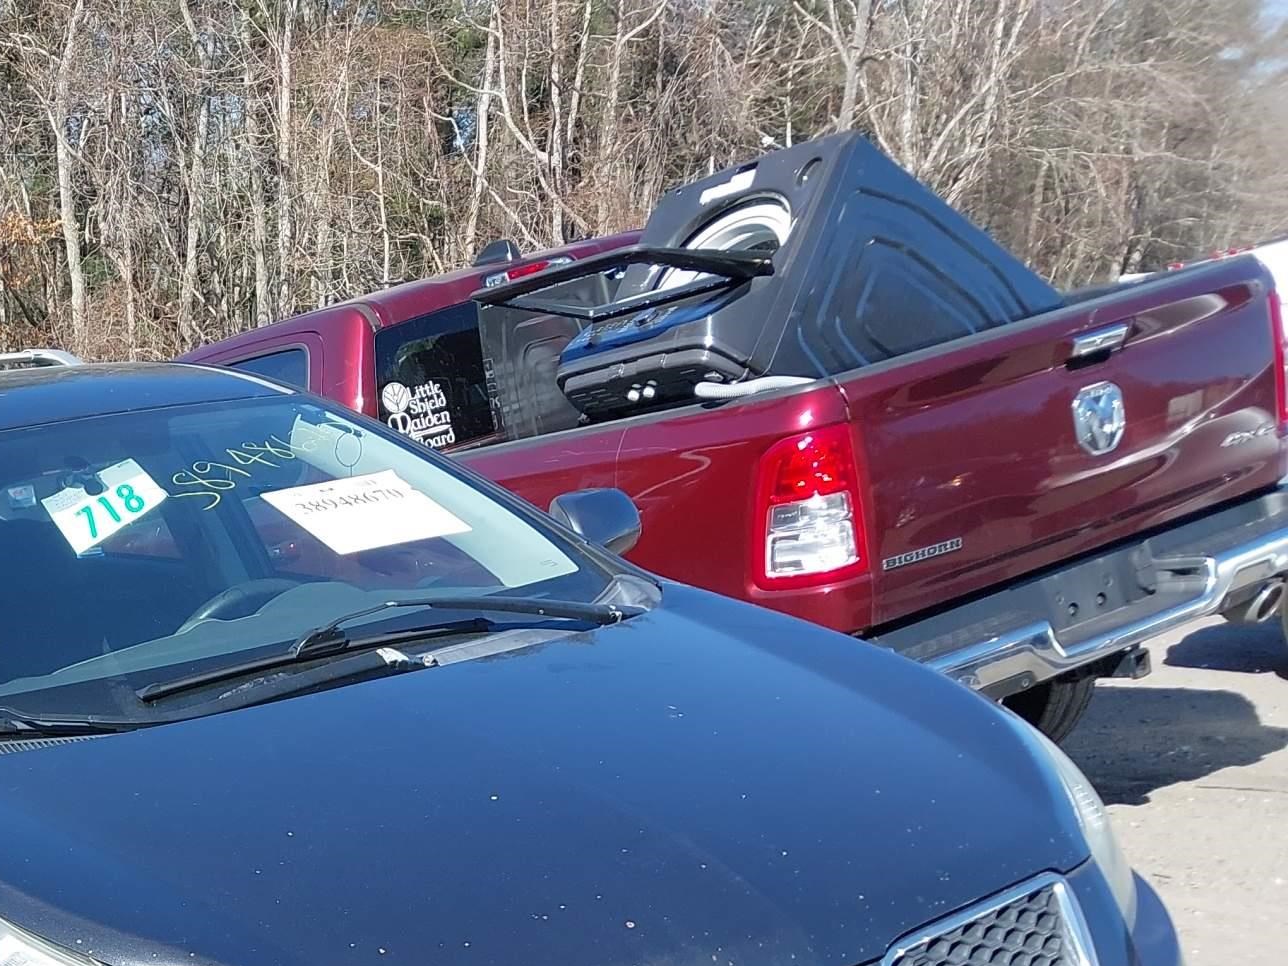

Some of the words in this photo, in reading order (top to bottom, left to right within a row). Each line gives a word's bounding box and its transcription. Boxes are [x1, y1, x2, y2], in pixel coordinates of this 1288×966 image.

[406, 380, 443, 401] Little
[409, 392, 447, 414] Shield
[75, 484, 145, 538] 718
[882, 537, 962, 571] BIGHORN
